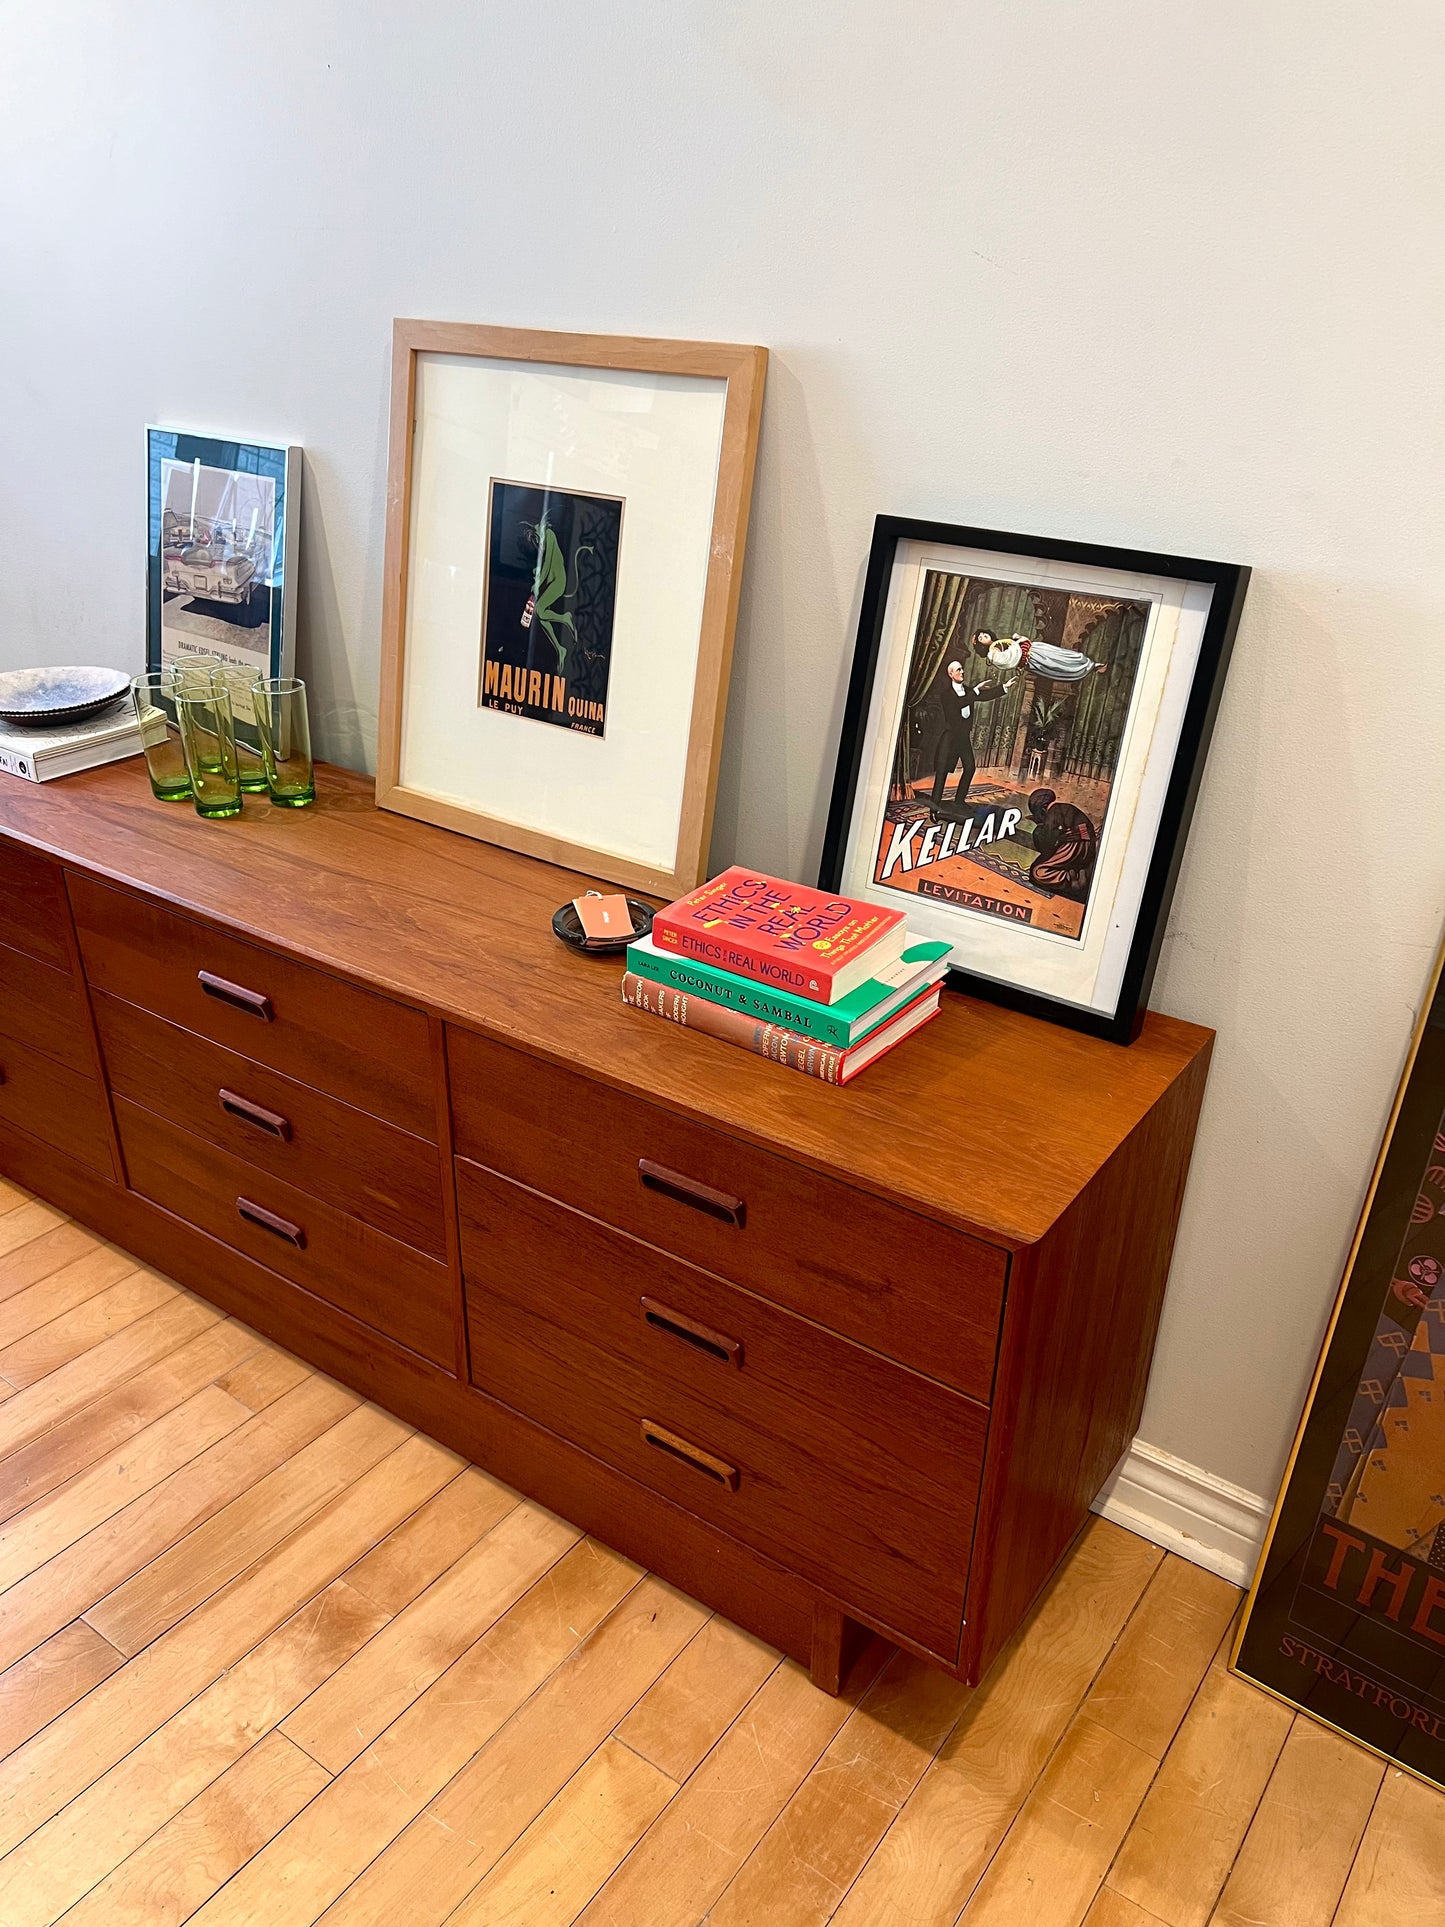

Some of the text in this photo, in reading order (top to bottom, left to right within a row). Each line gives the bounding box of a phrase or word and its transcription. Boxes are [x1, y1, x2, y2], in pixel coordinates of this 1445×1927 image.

[484, 659, 604, 722] MAURIN QUINA
[489, 699, 523, 715] LE PUY
[571, 722, 596, 734] FRANCE
[880, 807, 1022, 881] KELLAR
[686, 882, 727, 906] Peter Singer
[691, 879, 768, 923] ETHICS
[728, 890, 792, 929] IN THE
[923, 882, 1027, 919] LEVITATION
[757, 904, 817, 936] REAL
[773, 901, 852, 951] WORLD
[820, 944, 846, 959] Things
[840, 931, 860, 945] That
[853, 916, 879, 934] Matter
[824, 925, 851, 943] Essays
[682, 935, 721, 960] ETHICS
[728, 951, 756, 972] REAL
[759, 962, 805, 987] WORLD
[635, 979, 643, 1008] ORIZON
[669, 969, 813, 1029] COCONUT & SAMBAL
[681, 994, 689, 1025] HOUGHT
[1322, 1523, 1445, 1646] THE
